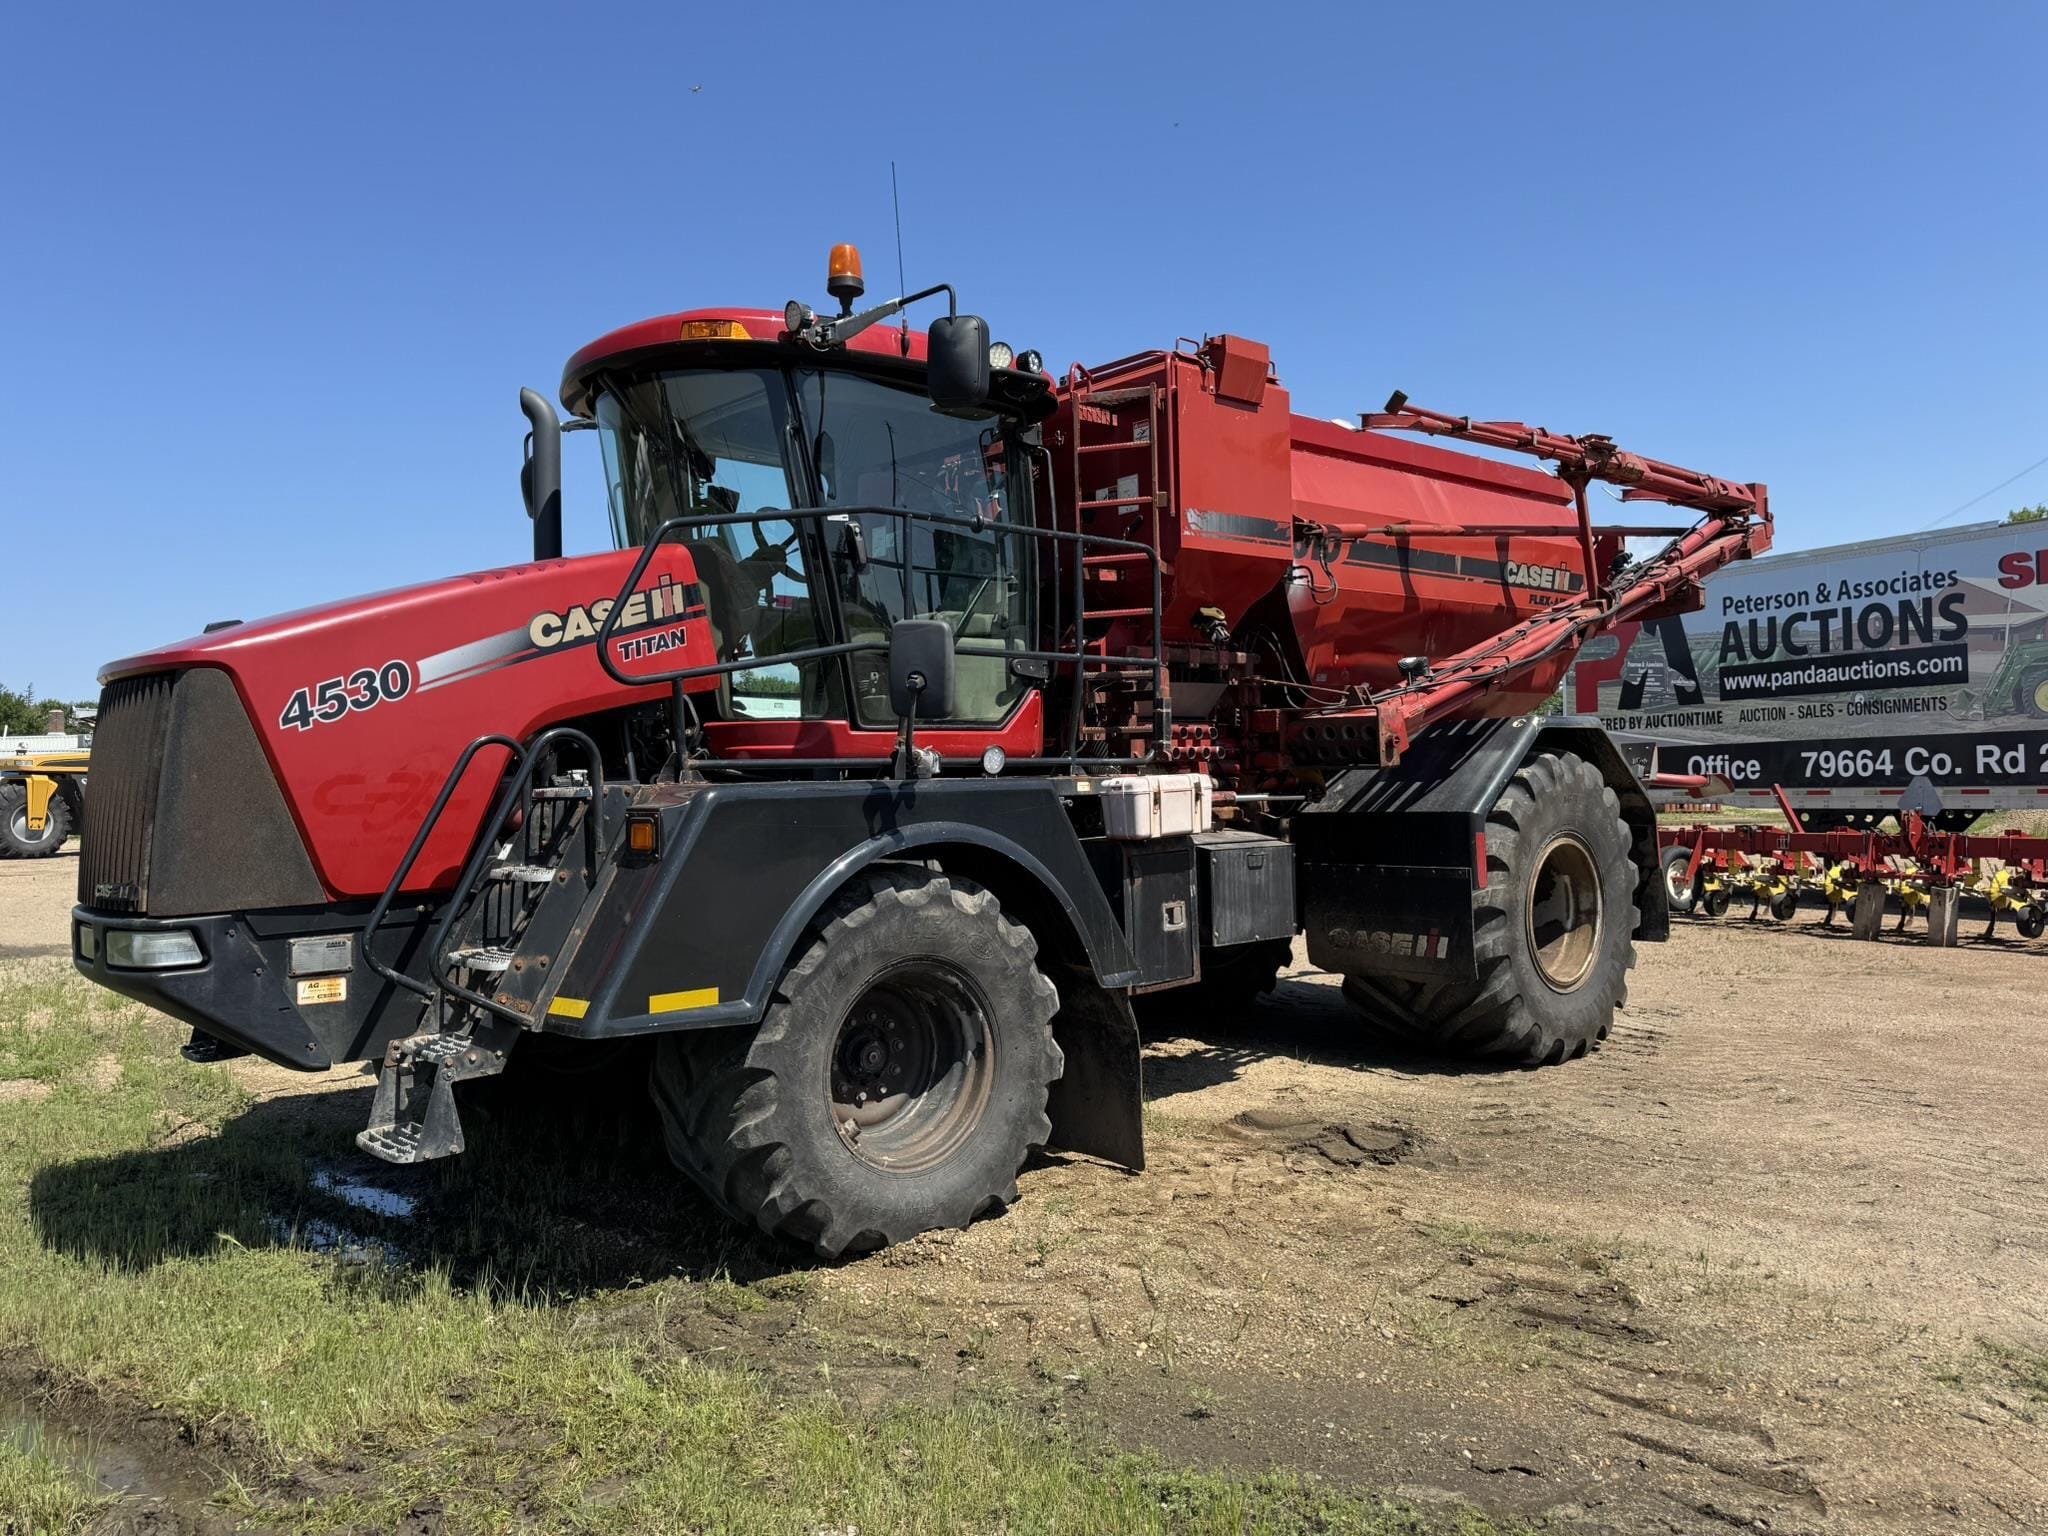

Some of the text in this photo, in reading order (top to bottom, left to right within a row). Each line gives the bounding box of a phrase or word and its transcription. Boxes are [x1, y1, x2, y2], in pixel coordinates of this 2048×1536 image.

[1722, 569, 1958, 617] Peterson & Associates
[617, 626, 687, 663] TITAN
[1719, 592, 1968, 664] AUCTIONS
[1723, 656, 1963, 691] www.pandaauctions.com
[280, 660, 412, 732] 4530
[1739, 706, 1786, 722] AUCTION
[1798, 703, 1834, 719] SALES
[1846, 695, 1948, 716] CONSIGNMENTS
[1628, 716, 1643, 730] BY
[1645, 710, 1723, 729] AUCTIONTIME
[1687, 754, 1760, 780] Office
[1801, 748, 1894, 778] 79664
[1904, 746, 1962, 776] Co.
[1976, 743, 2026, 776] Rd
